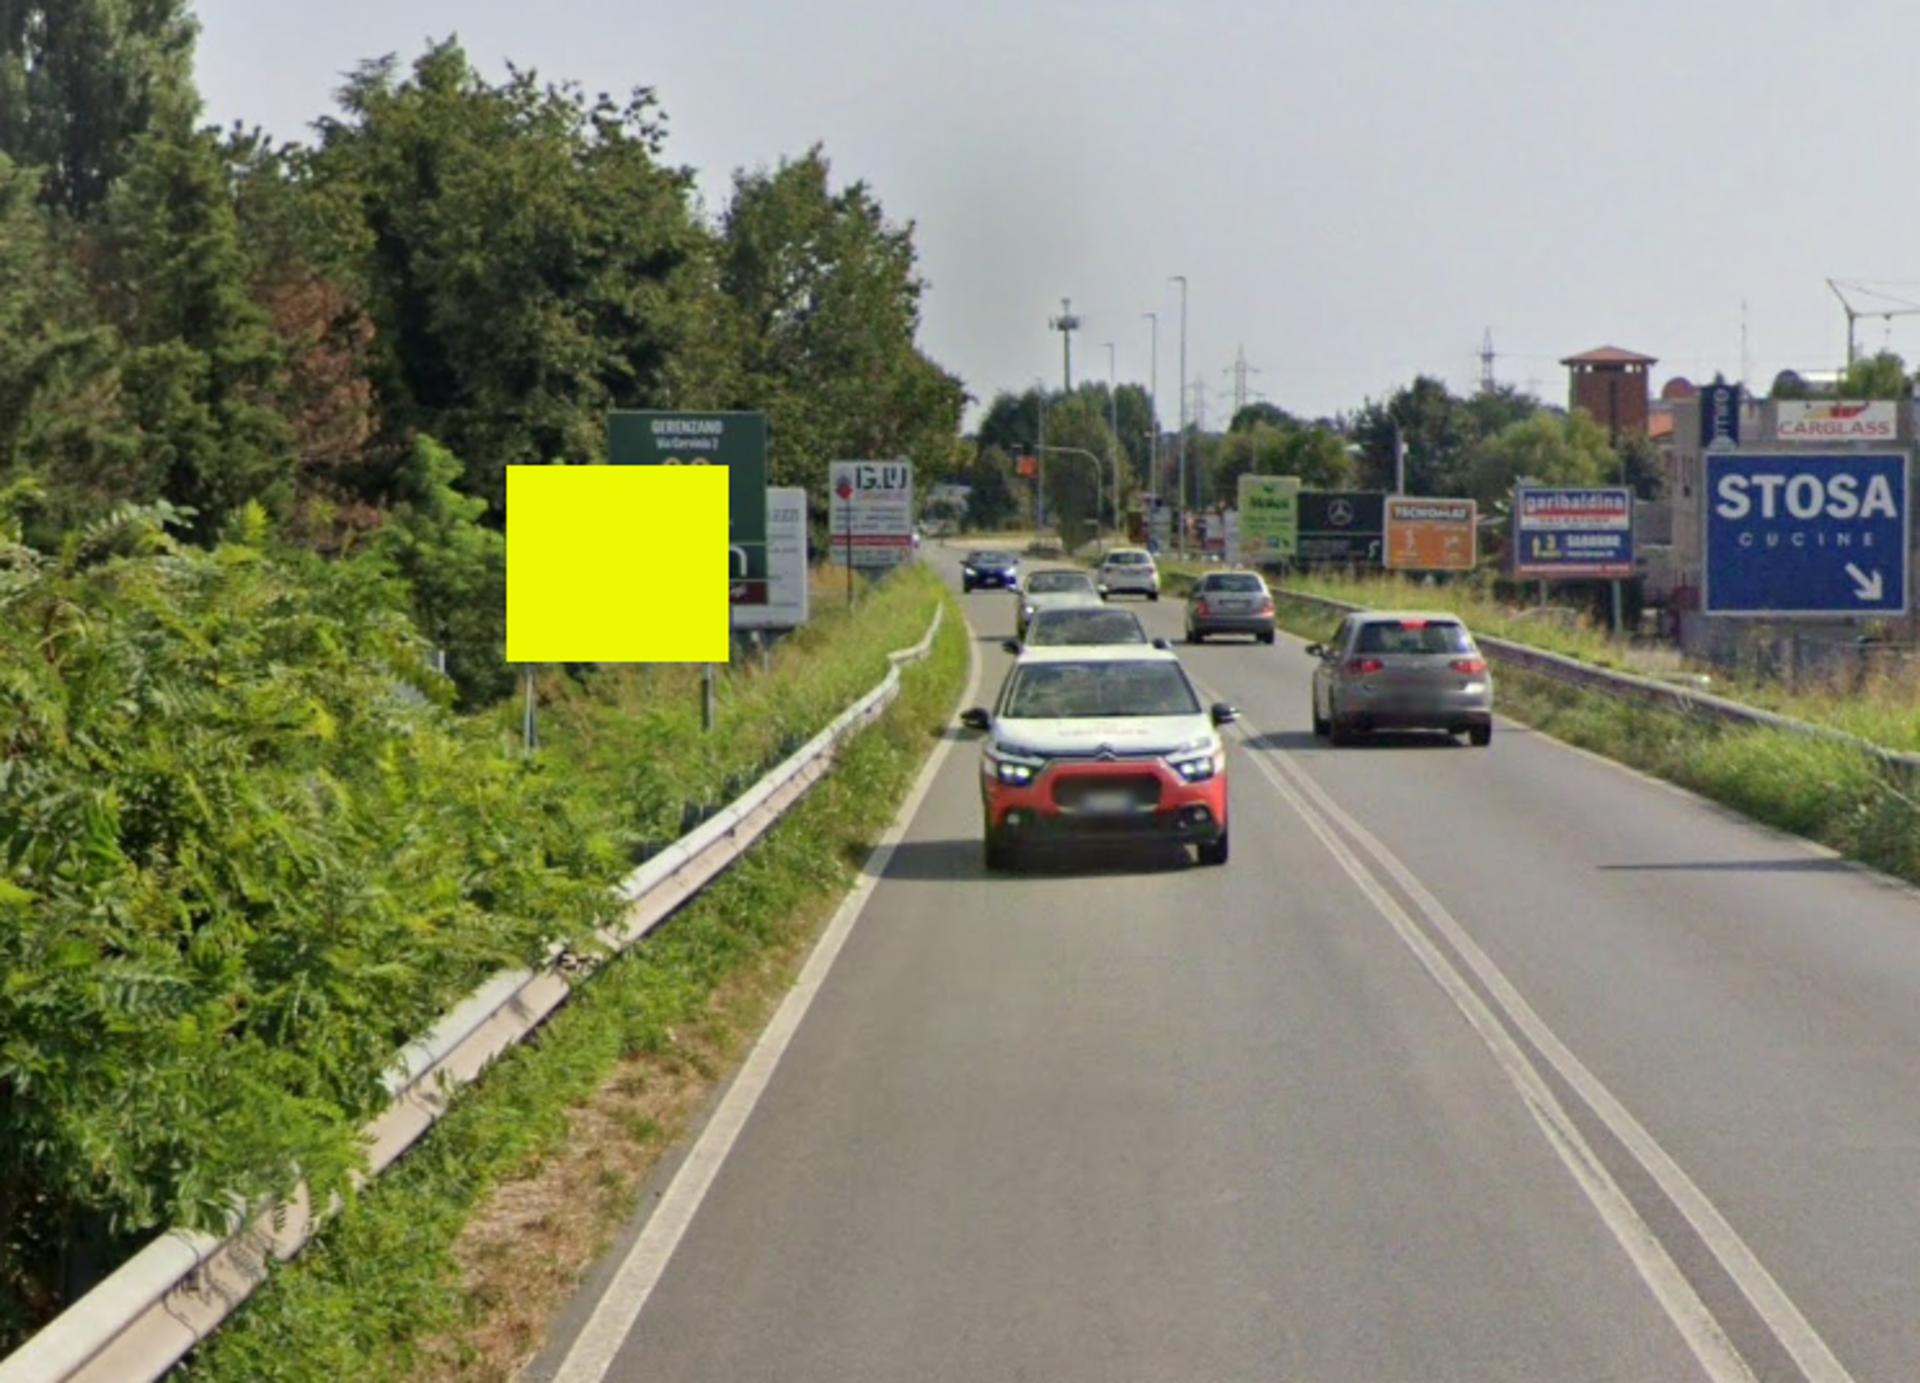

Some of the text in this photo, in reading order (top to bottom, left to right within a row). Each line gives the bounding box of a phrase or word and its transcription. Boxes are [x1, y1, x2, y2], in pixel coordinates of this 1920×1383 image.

[1777, 420, 1890, 435] CARGLASS
[1716, 474, 1896, 518] STOSA
[1738, 532, 1874, 547] CUCINE
